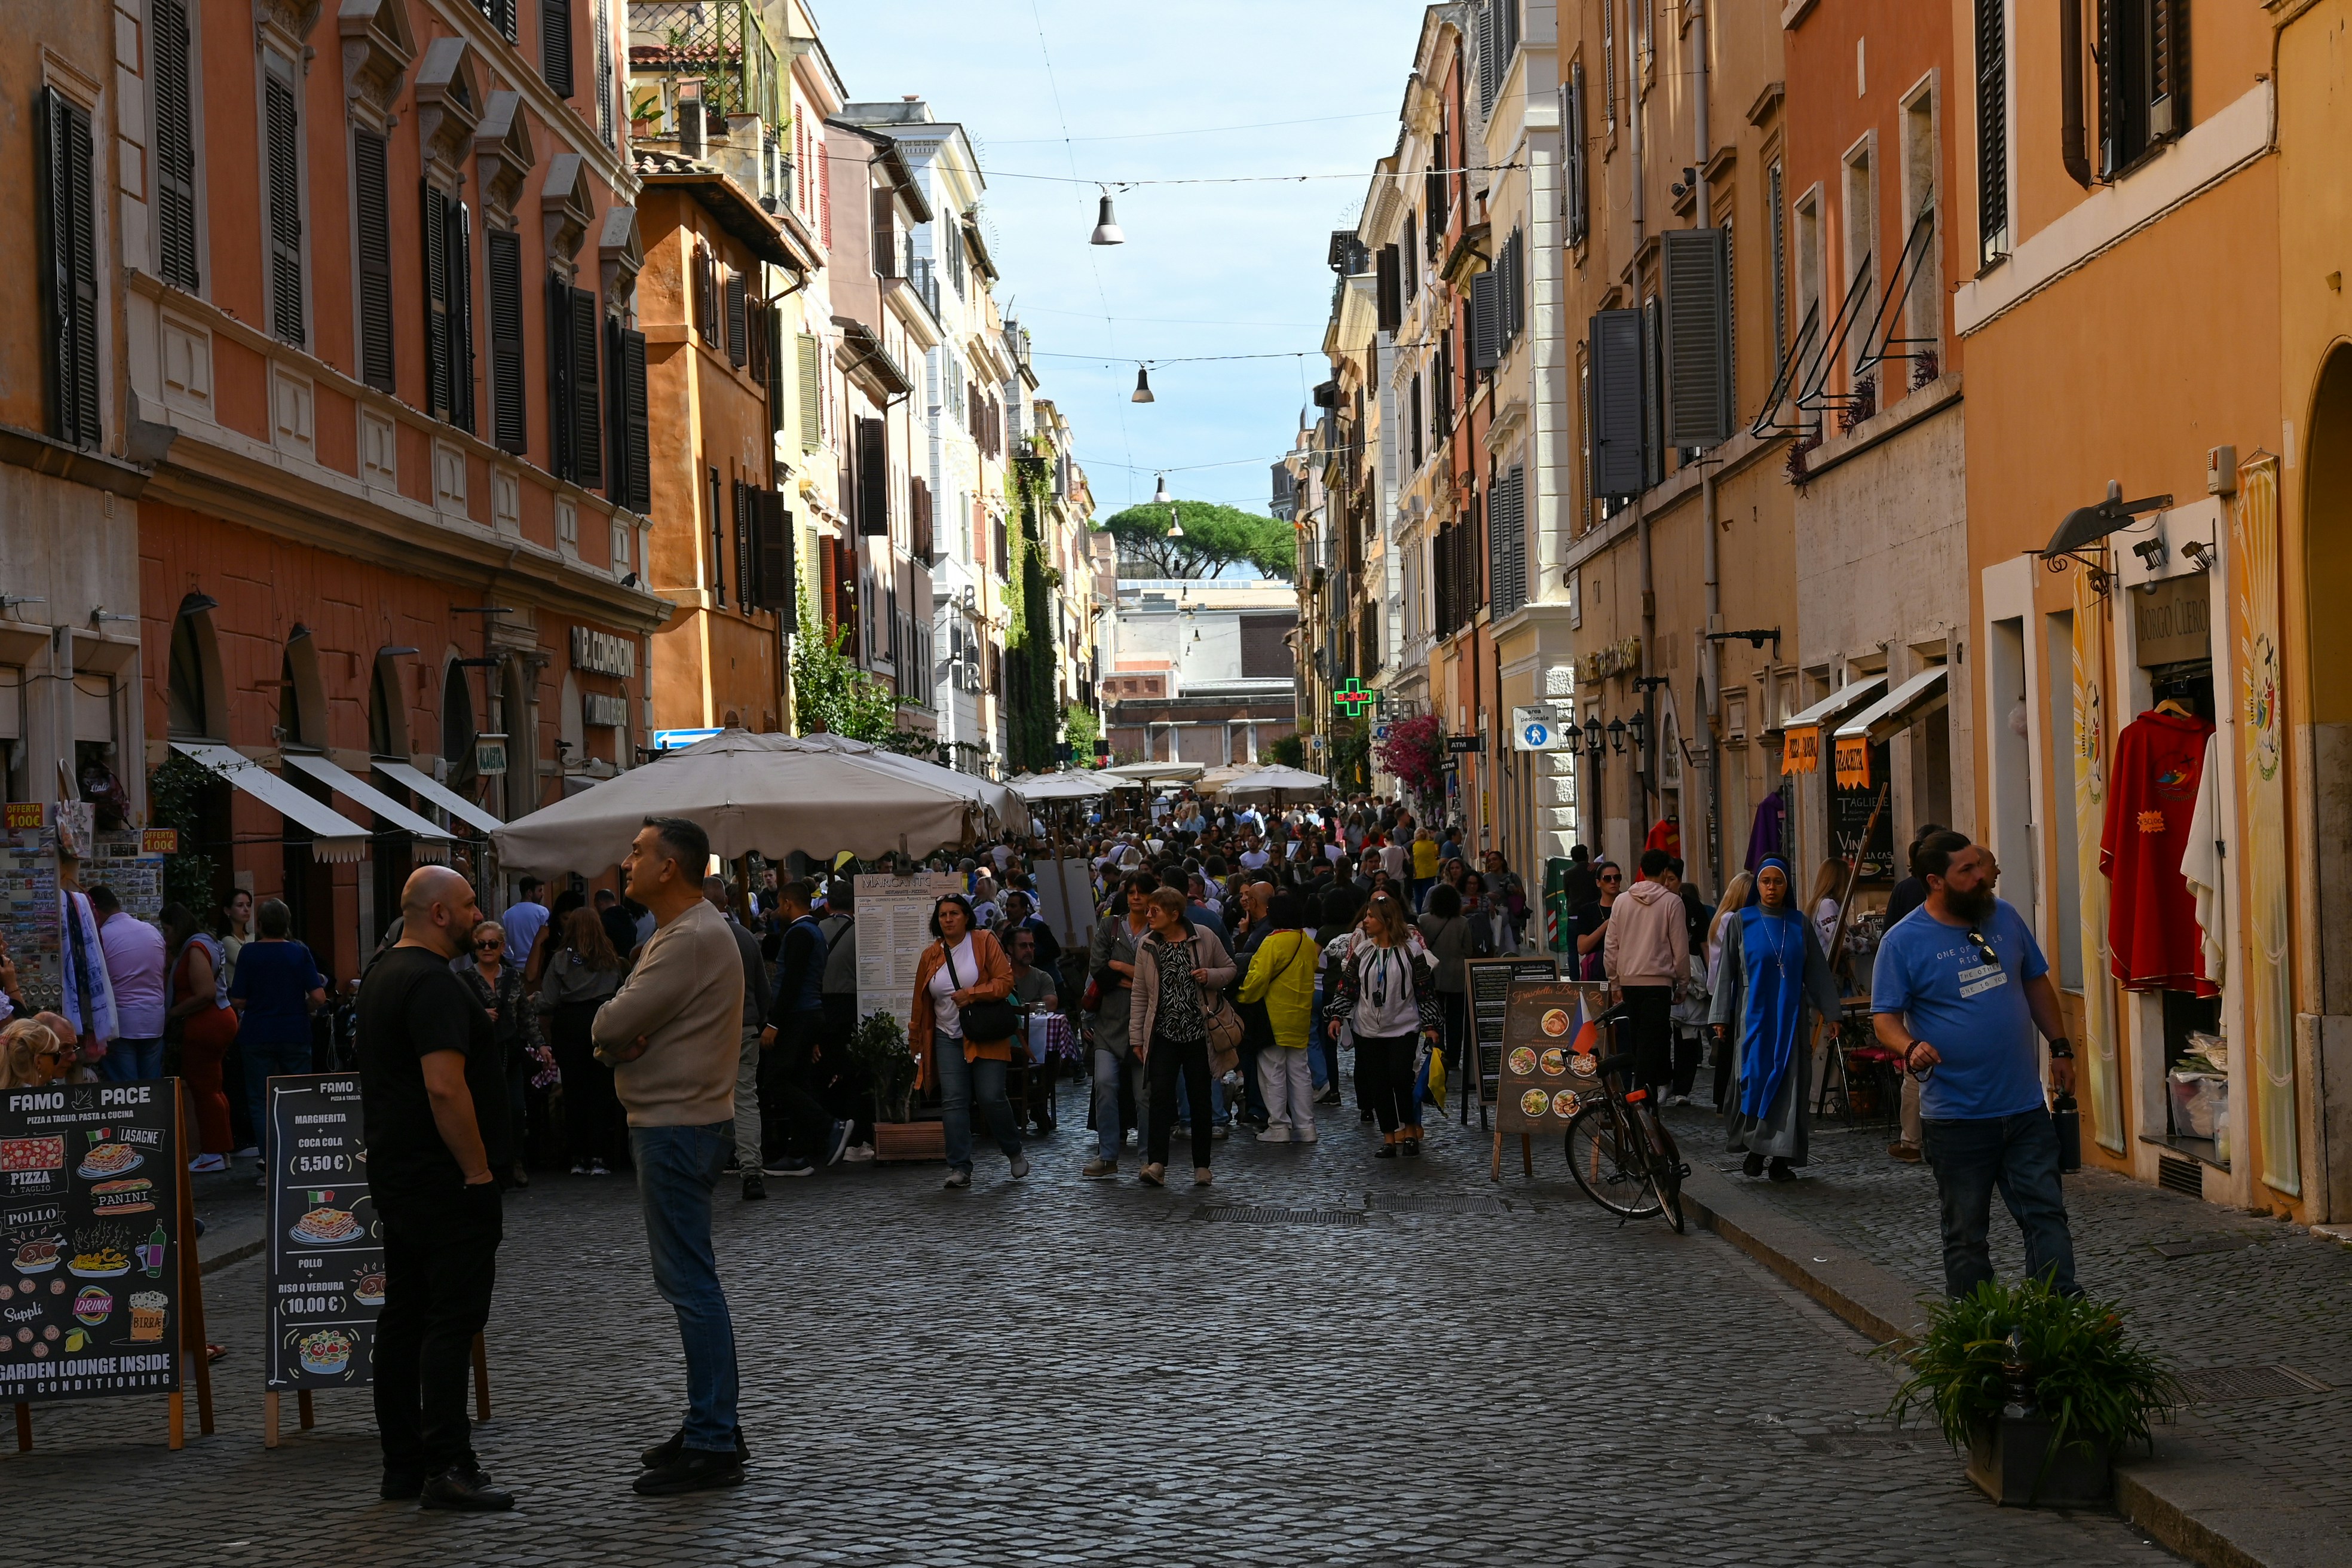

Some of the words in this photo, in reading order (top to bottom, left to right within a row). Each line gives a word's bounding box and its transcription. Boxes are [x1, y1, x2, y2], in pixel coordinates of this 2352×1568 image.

[2140, 605, 2172, 641] BORGO
[2175, 598, 2207, 636] CLERO
[593, 631, 634, 678] COMANDINI
[1441, 762, 1455, 770] ATM
[7, 805, 40, 813] OFFERTA
[1837, 797, 1889, 814] TAGLIEE
[7, 814, 41, 828] 1.00€
[145, 839, 174, 851] 1.00€
[1836, 831, 1861, 850] VIN
[1878, 852, 1892, 860] CAS
[1937, 949, 1955, 960] ONE
[1959, 945, 1970, 954] OF
[1992, 935, 2002, 943] IS
[1959, 955, 1978, 965] RIG
[1959, 972, 1974, 980] THE
[1977, 963, 2001, 975] OTHER
[1556, 983, 1579, 999] Borg
[1961, 987, 1976, 996] ONE
[1994, 975, 2007, 984] YOU
[320, 1081, 354, 1094] FAMO
[9, 1092, 64, 1112] FAMO
[100, 1086, 151, 1105] PACE
[27, 1116, 45, 1125] PIZZA
[52, 1113, 78, 1123] TAGLIO,
[78, 1112, 100, 1121] PASTA
[108, 1110, 133, 1120] CUCINA
[295, 1113, 347, 1125] MARGHERITA
[120, 1128, 158, 1144] LASAGNE
[298, 1138, 320, 1148] COCA
[321, 1137, 343, 1147] COLA
[300, 1156, 331, 1172] 5,50
[333, 1155, 344, 1170] €
[10, 1171, 50, 1186] PIZZA
[99, 1191, 148, 1206] PANINI
[8, 1208, 56, 1225] POLLO
[73, 1247, 127, 1269] pasta
[298, 1258, 323, 1269] POLLO
[278, 1283, 298, 1293] RISO
[299, 1283, 305, 1292] O
[306, 1281, 344, 1292] VERDURA
[76, 1298, 111, 1312] DRINK
[287, 1296, 326, 1314] 10,00
[327, 1296, 338, 1312] €
[133, 1316, 161, 1328] BIRRA
[0, 1361, 56, 1380] GARDEN
[59, 1357, 117, 1377] LOUNGE
[120, 1353, 170, 1373] INSIDE
[38, 1373, 170, 1394] CONDITIONING
